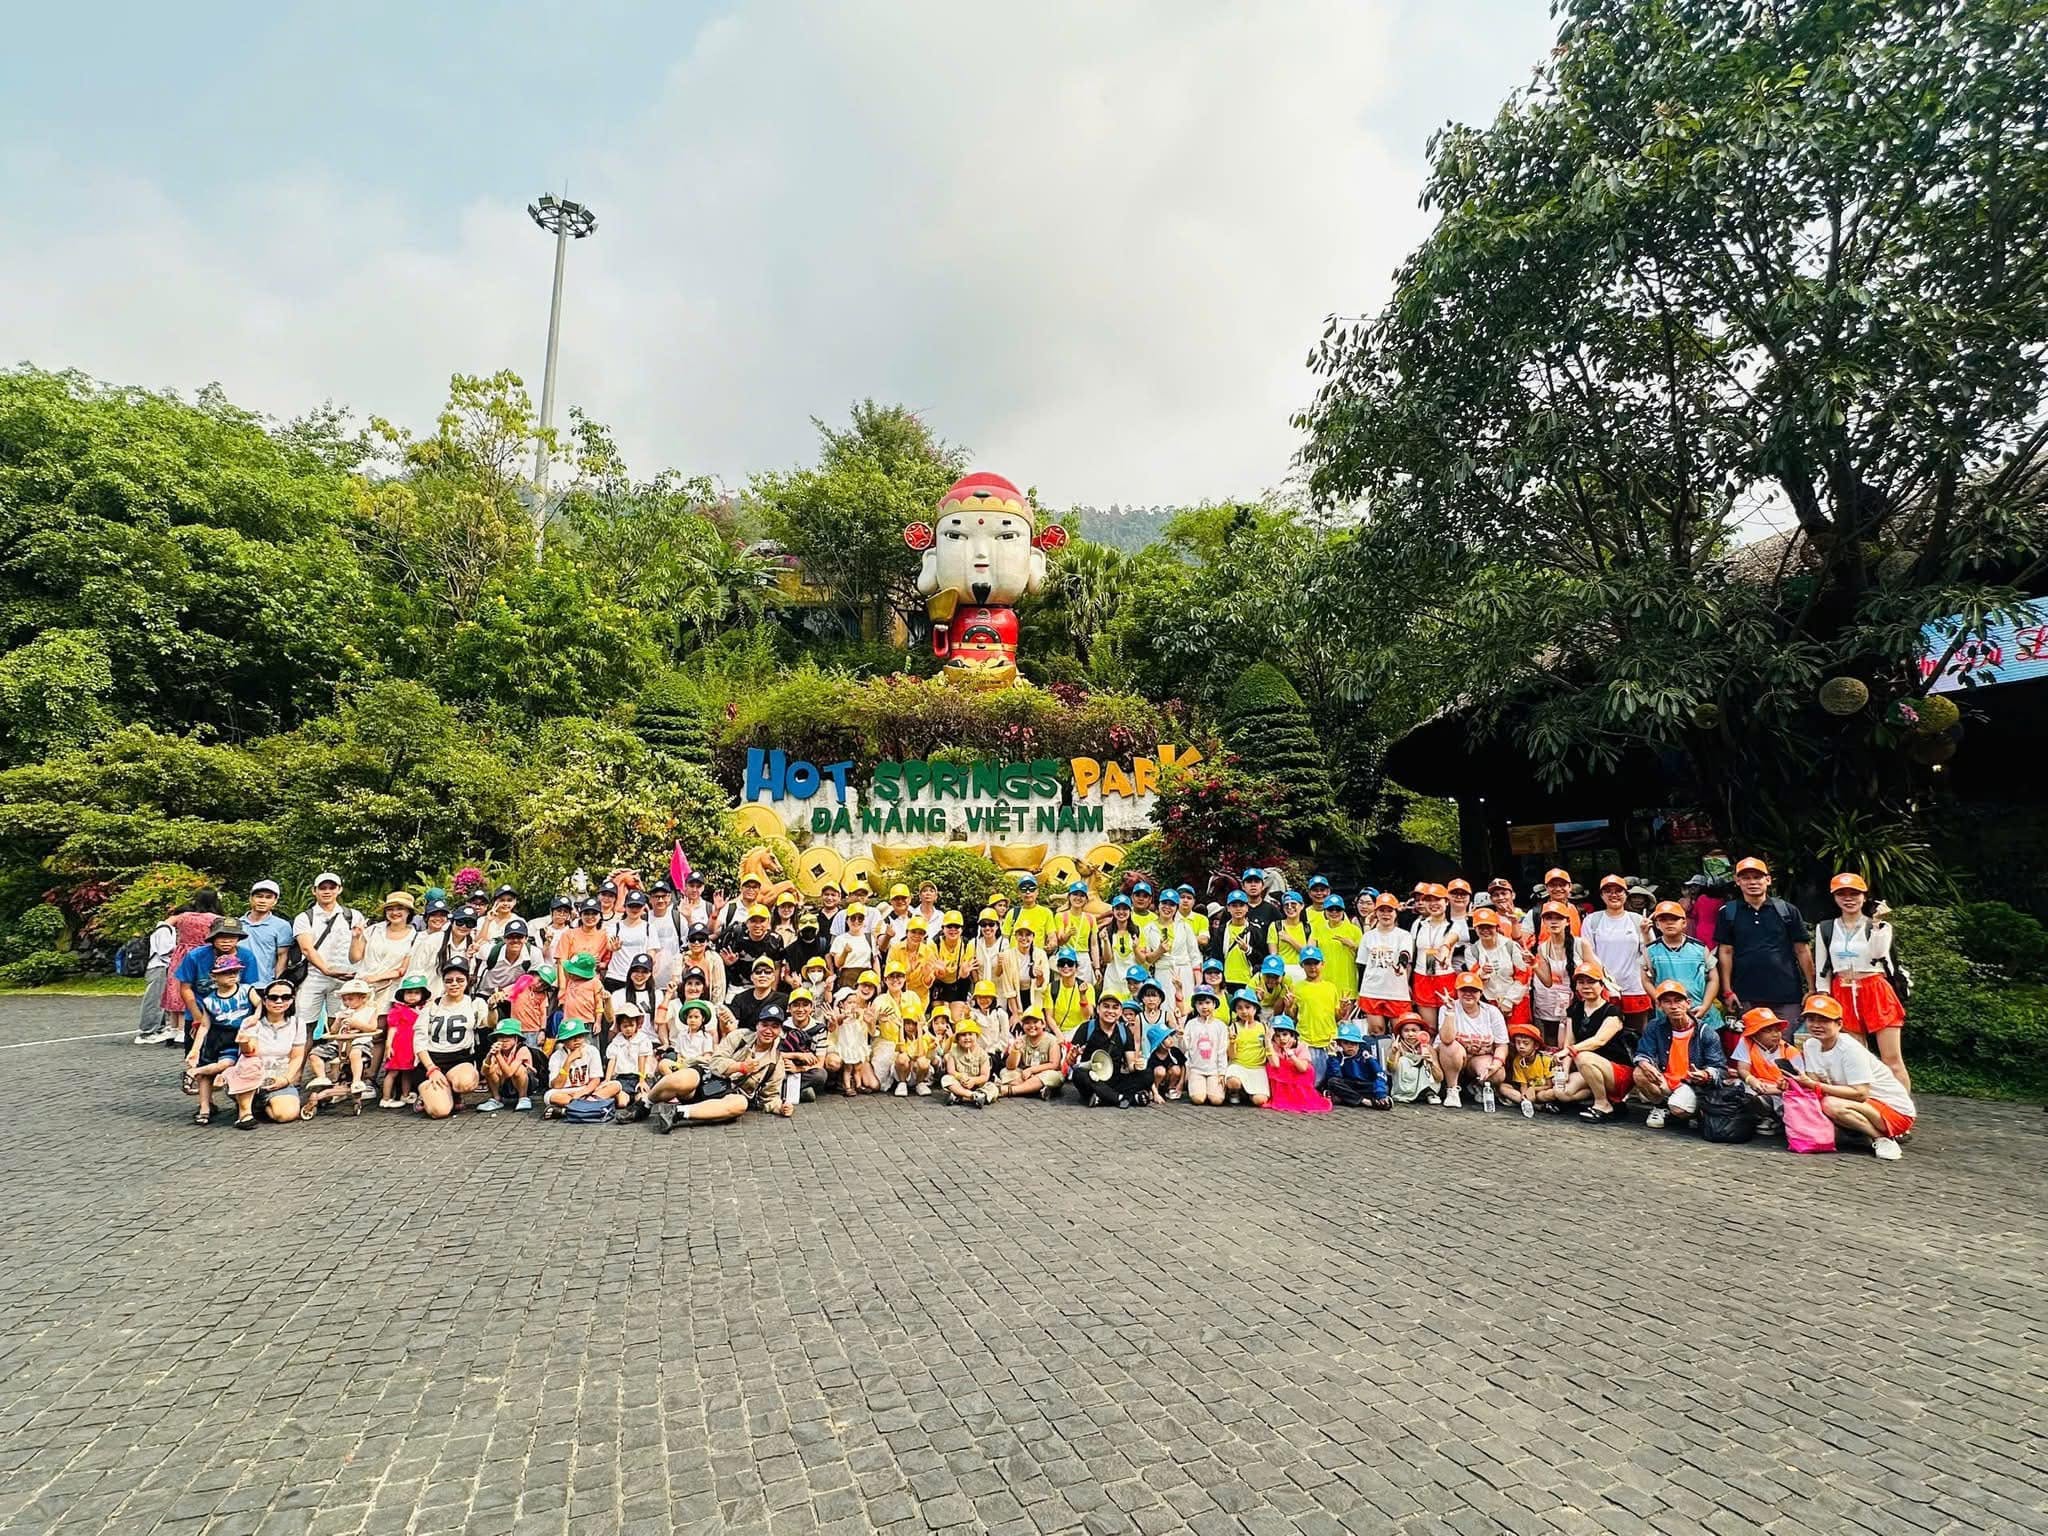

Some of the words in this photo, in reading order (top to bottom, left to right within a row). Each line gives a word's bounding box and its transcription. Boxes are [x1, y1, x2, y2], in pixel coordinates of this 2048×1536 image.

[746, 746, 855, 805] HOT
[1071, 744, 1203, 799] PARK
[964, 798, 1029, 841] VIỆT
[1036, 807, 1104, 833] NAM
[431, 1014, 468, 1044] 76
